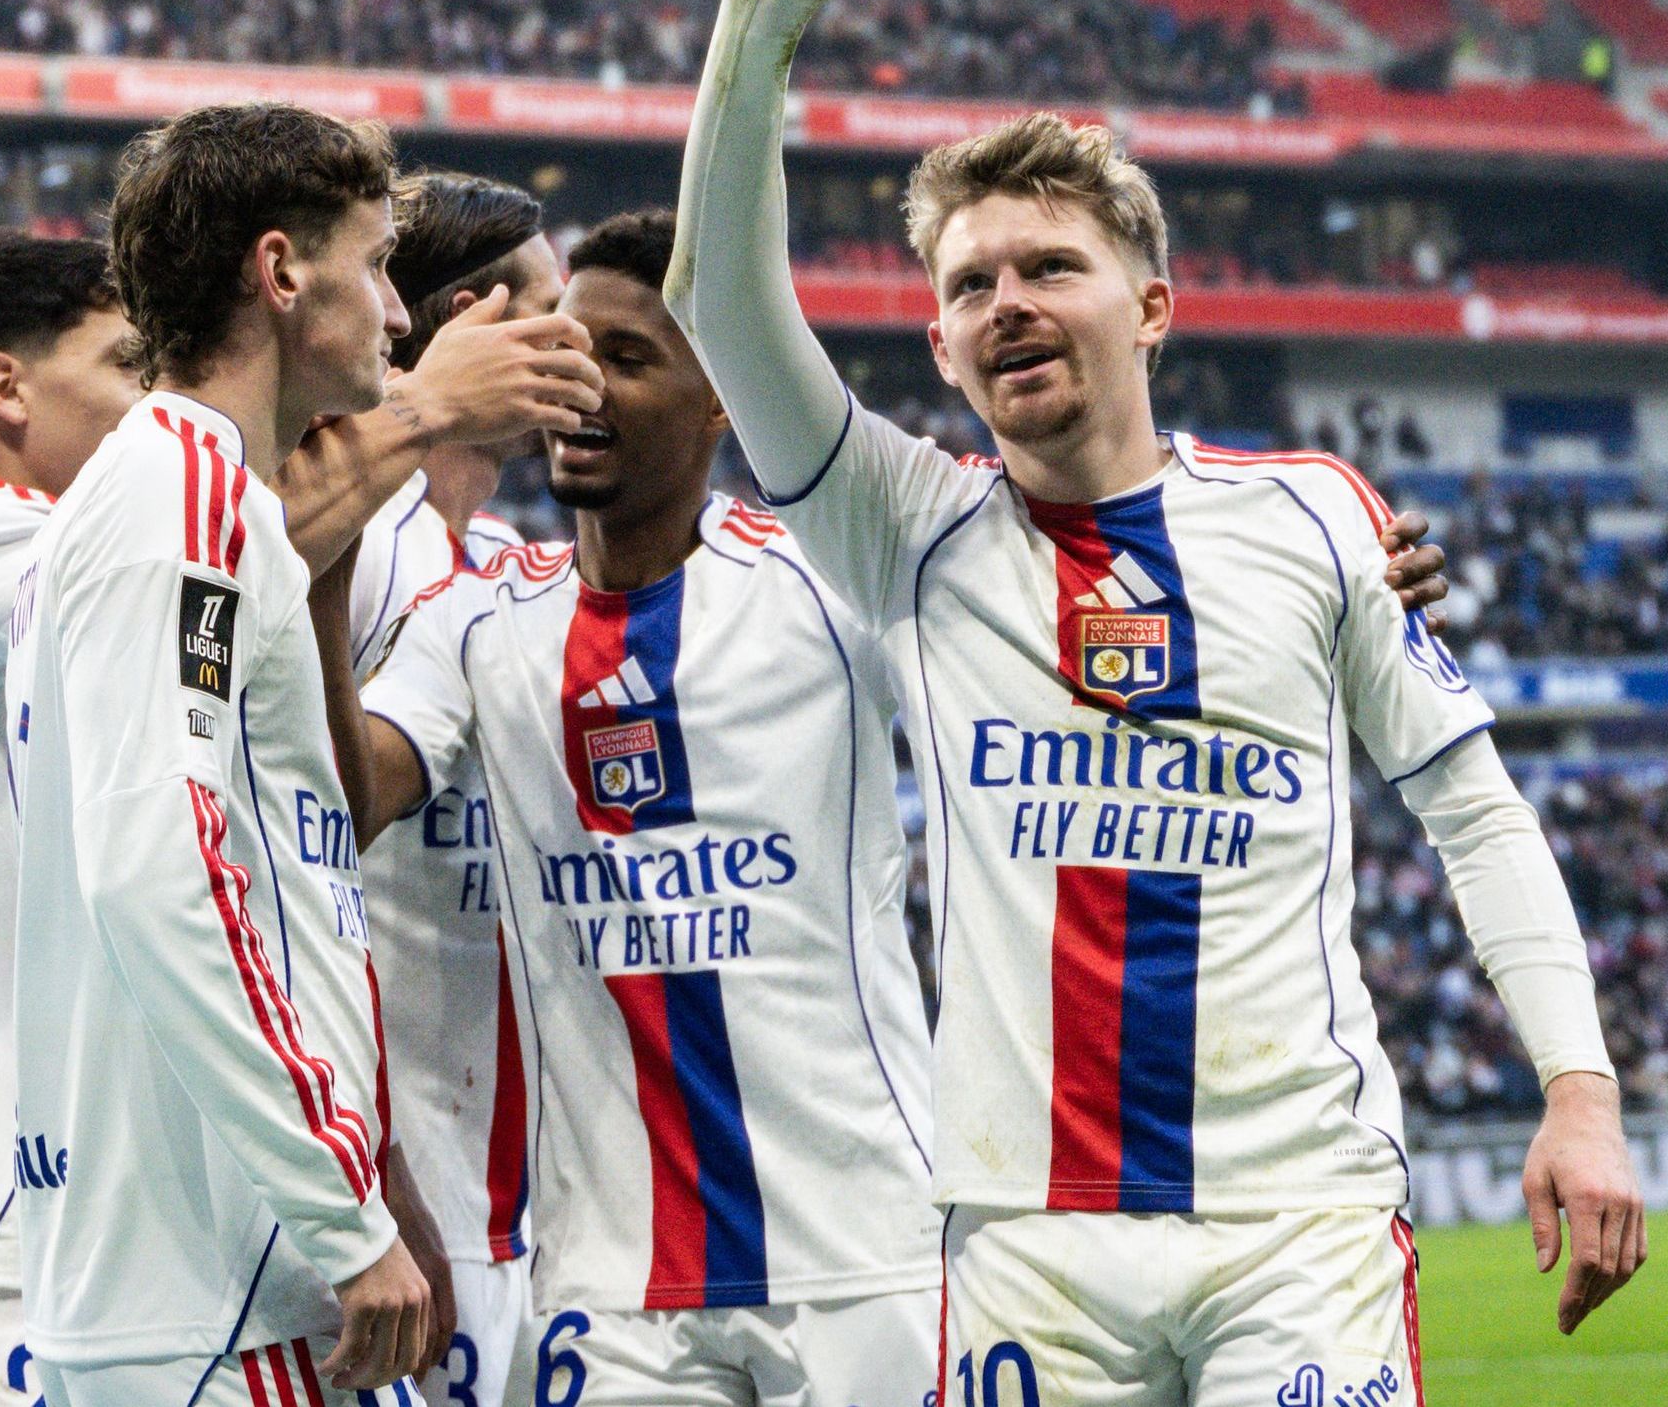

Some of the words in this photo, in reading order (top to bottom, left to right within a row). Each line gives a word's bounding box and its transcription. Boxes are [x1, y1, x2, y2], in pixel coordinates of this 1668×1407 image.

[1090, 621, 1161, 632] OLYMPIQUE
[1090, 631, 1161, 642] LYONNAIS
[592, 726, 650, 746] OLYMPIQUE
[594, 737, 653, 757] LYONNAIS
[969, 716, 1303, 805] Emirates
[1009, 801, 1080, 859] FLY
[1091, 803, 1255, 869] BETTER
[460, 861, 501, 912] FL
[624, 904, 751, 967] BETTER
[535, 1310, 591, 1407] 6
[957, 1340, 1041, 1407] 10
